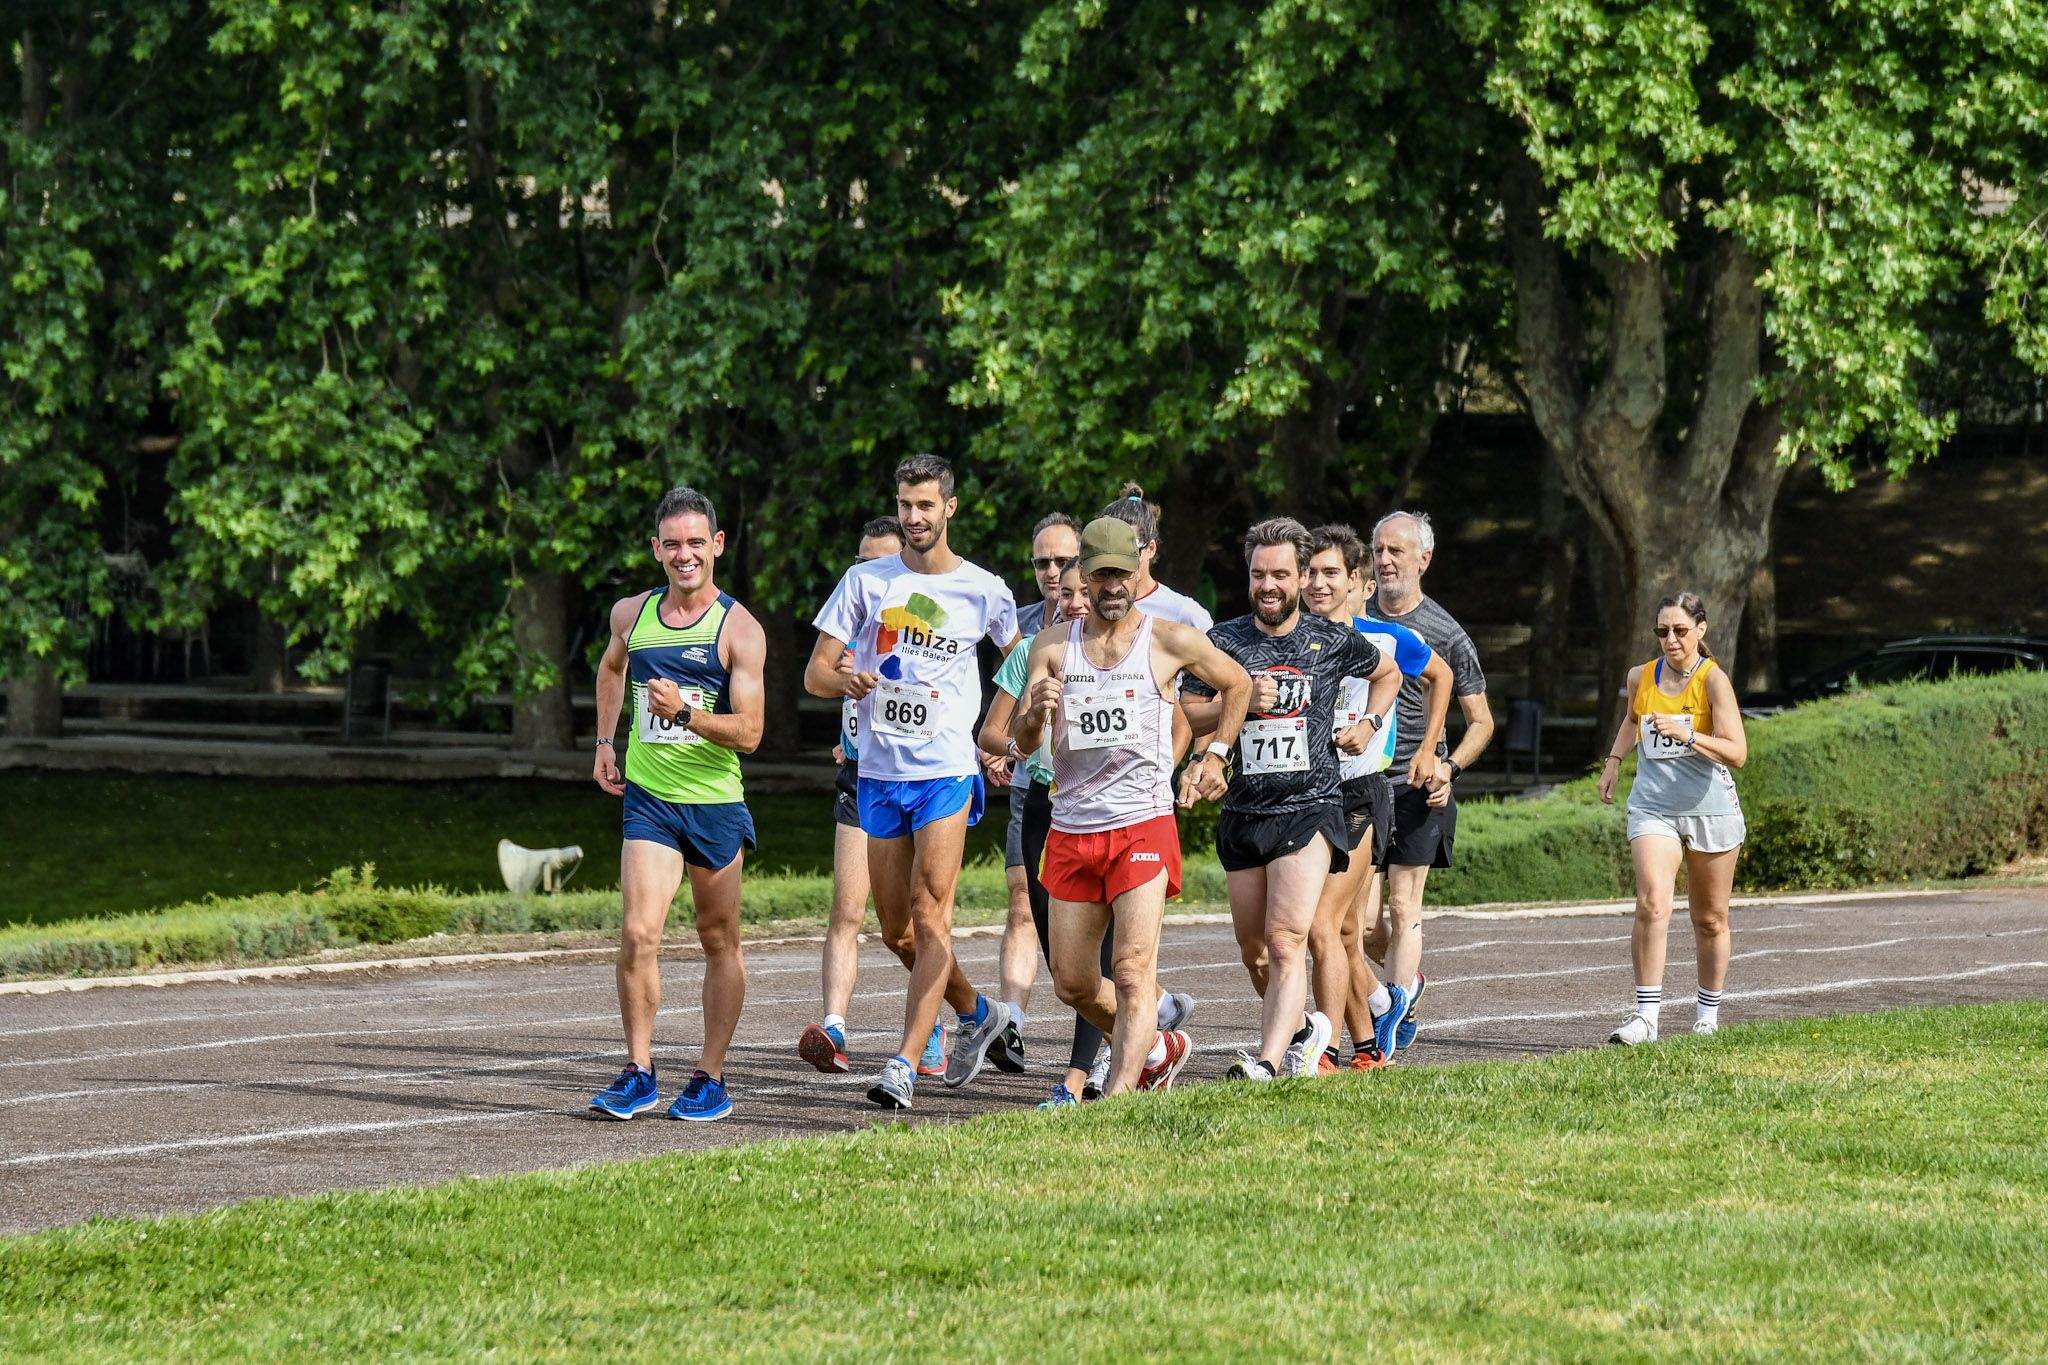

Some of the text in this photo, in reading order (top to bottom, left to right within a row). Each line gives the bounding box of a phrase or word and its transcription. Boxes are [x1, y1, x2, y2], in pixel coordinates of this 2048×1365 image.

[903, 625, 958, 655] Ibiza
[1111, 672, 1145, 681] ESPAÑA
[885, 699, 927, 726] 869
[1080, 707, 1127, 735] 803
[1252, 736, 1296, 761] 717
